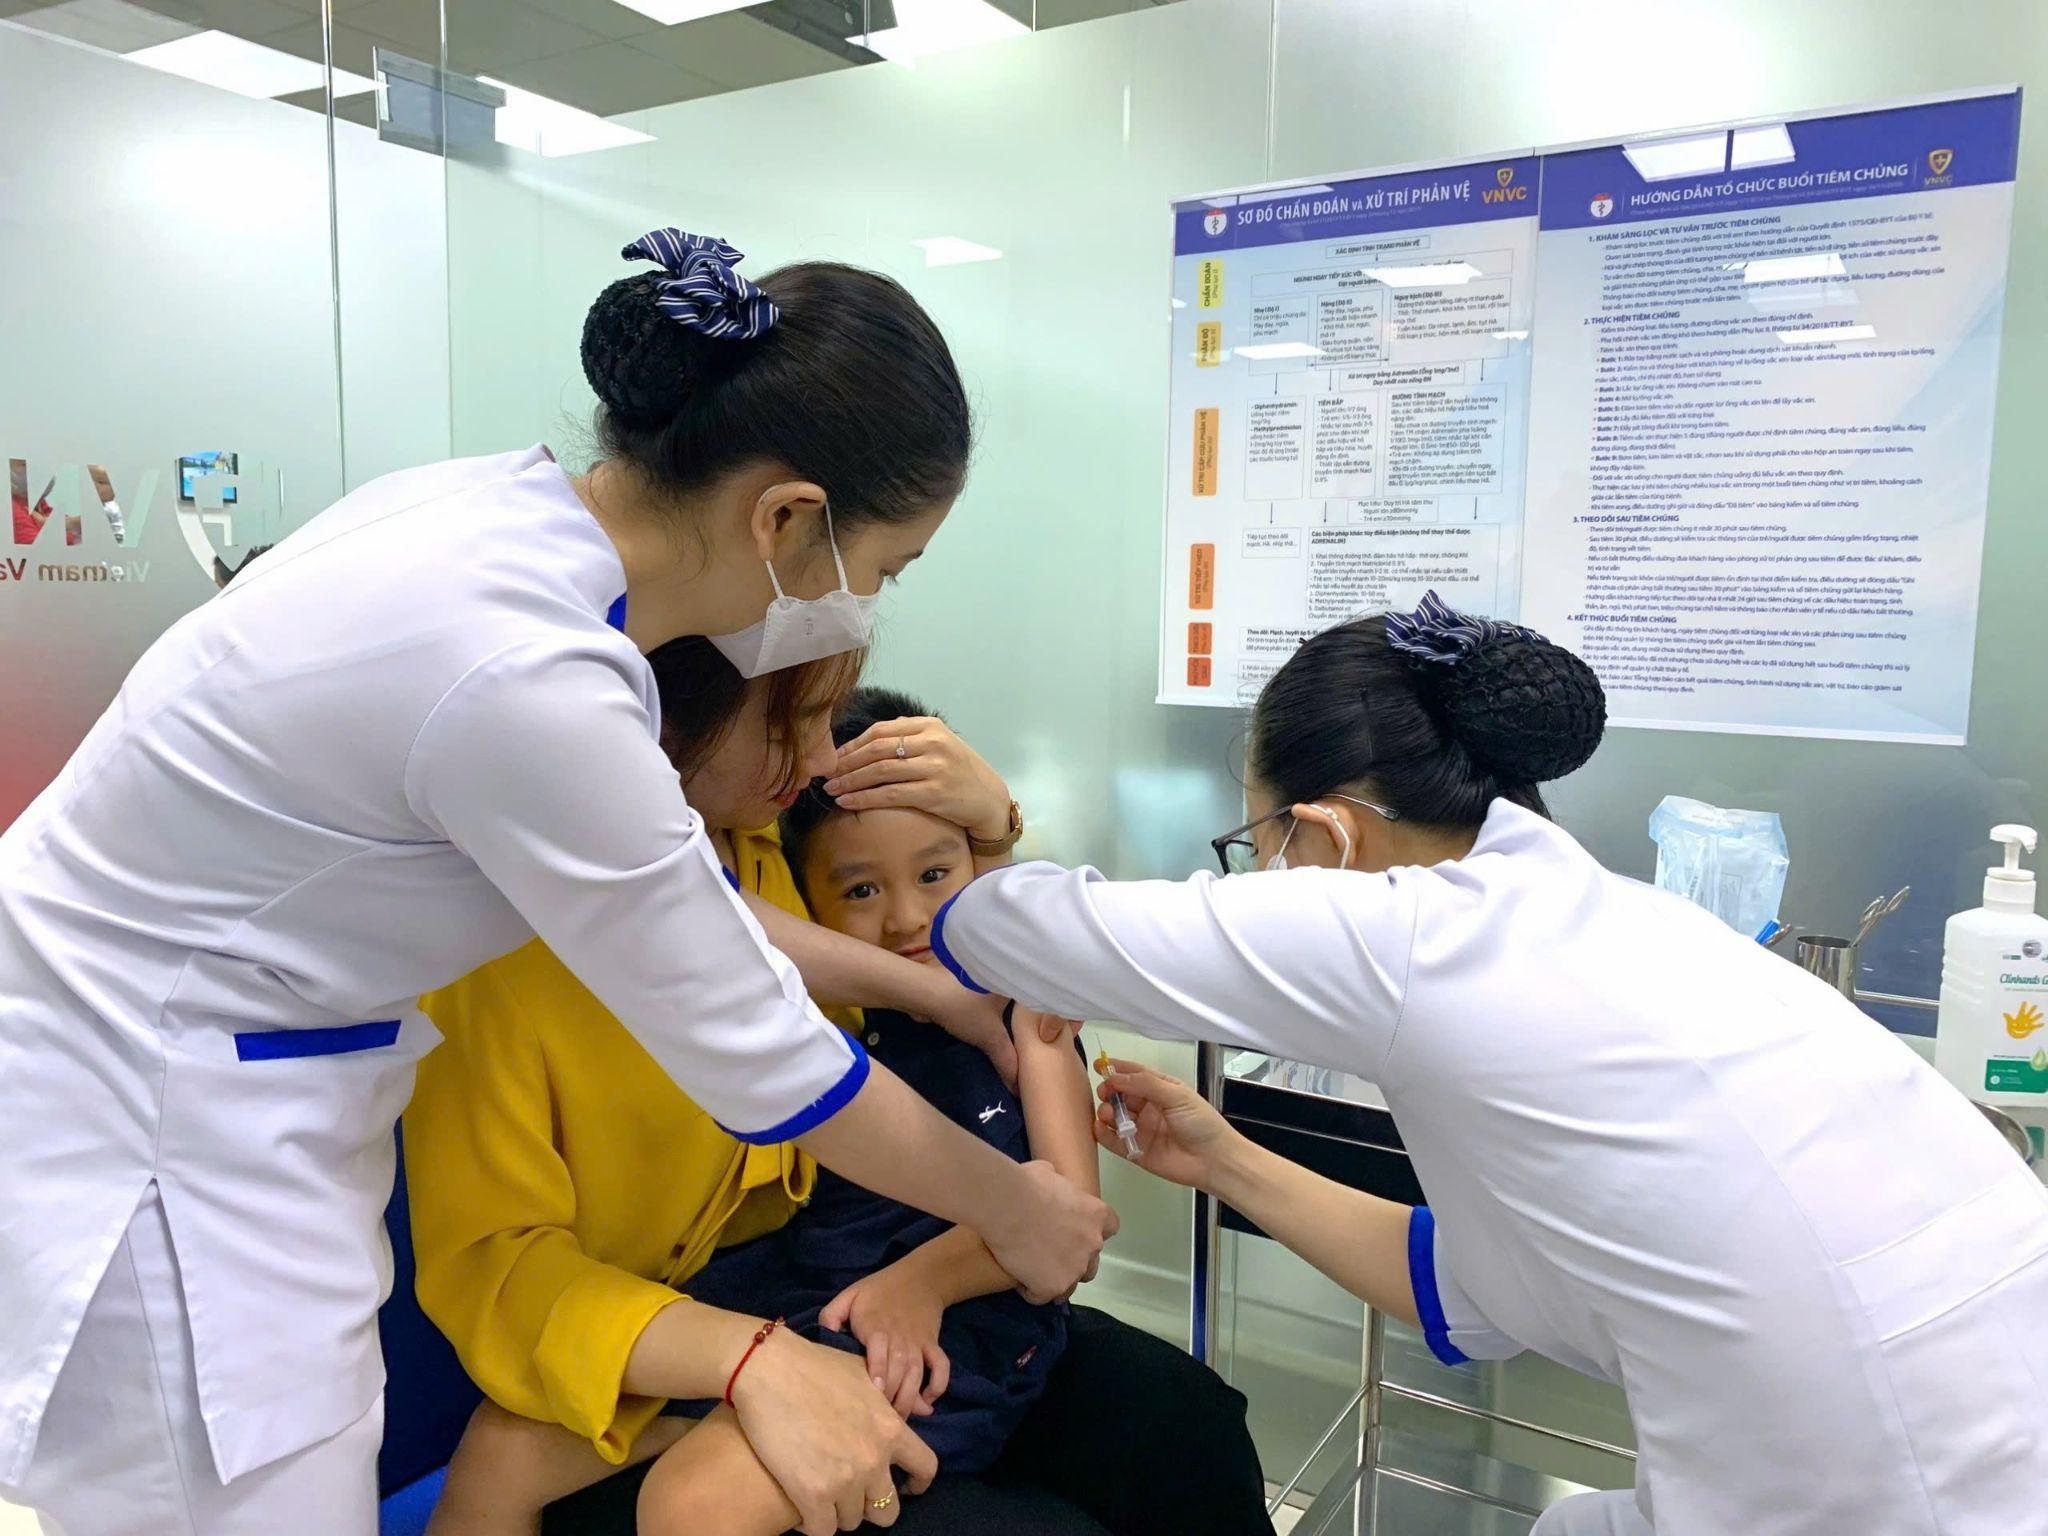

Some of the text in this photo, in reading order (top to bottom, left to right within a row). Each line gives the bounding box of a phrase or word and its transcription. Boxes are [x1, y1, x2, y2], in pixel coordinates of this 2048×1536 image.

[1631, 189, 1680, 205] HƯỚNG
[1683, 183, 1712, 200] DẪN
[1735, 178, 1775, 193] CHỨC
[1778, 171, 1813, 189] BUỔI
[1815, 170, 1850, 184] TIÊM
[1853, 163, 1908, 180] CHỦNG
[1924, 174, 1952, 185] VNVC
[1237, 208, 1253, 225] SƠ
[1312, 196, 1348, 215] ĐOÁN
[1386, 187, 1408, 206] TRÍ
[1411, 182, 1449, 203] PHẢN
[1453, 179, 1469, 201] VỆ
[1482, 186, 1527, 204] VNVC
